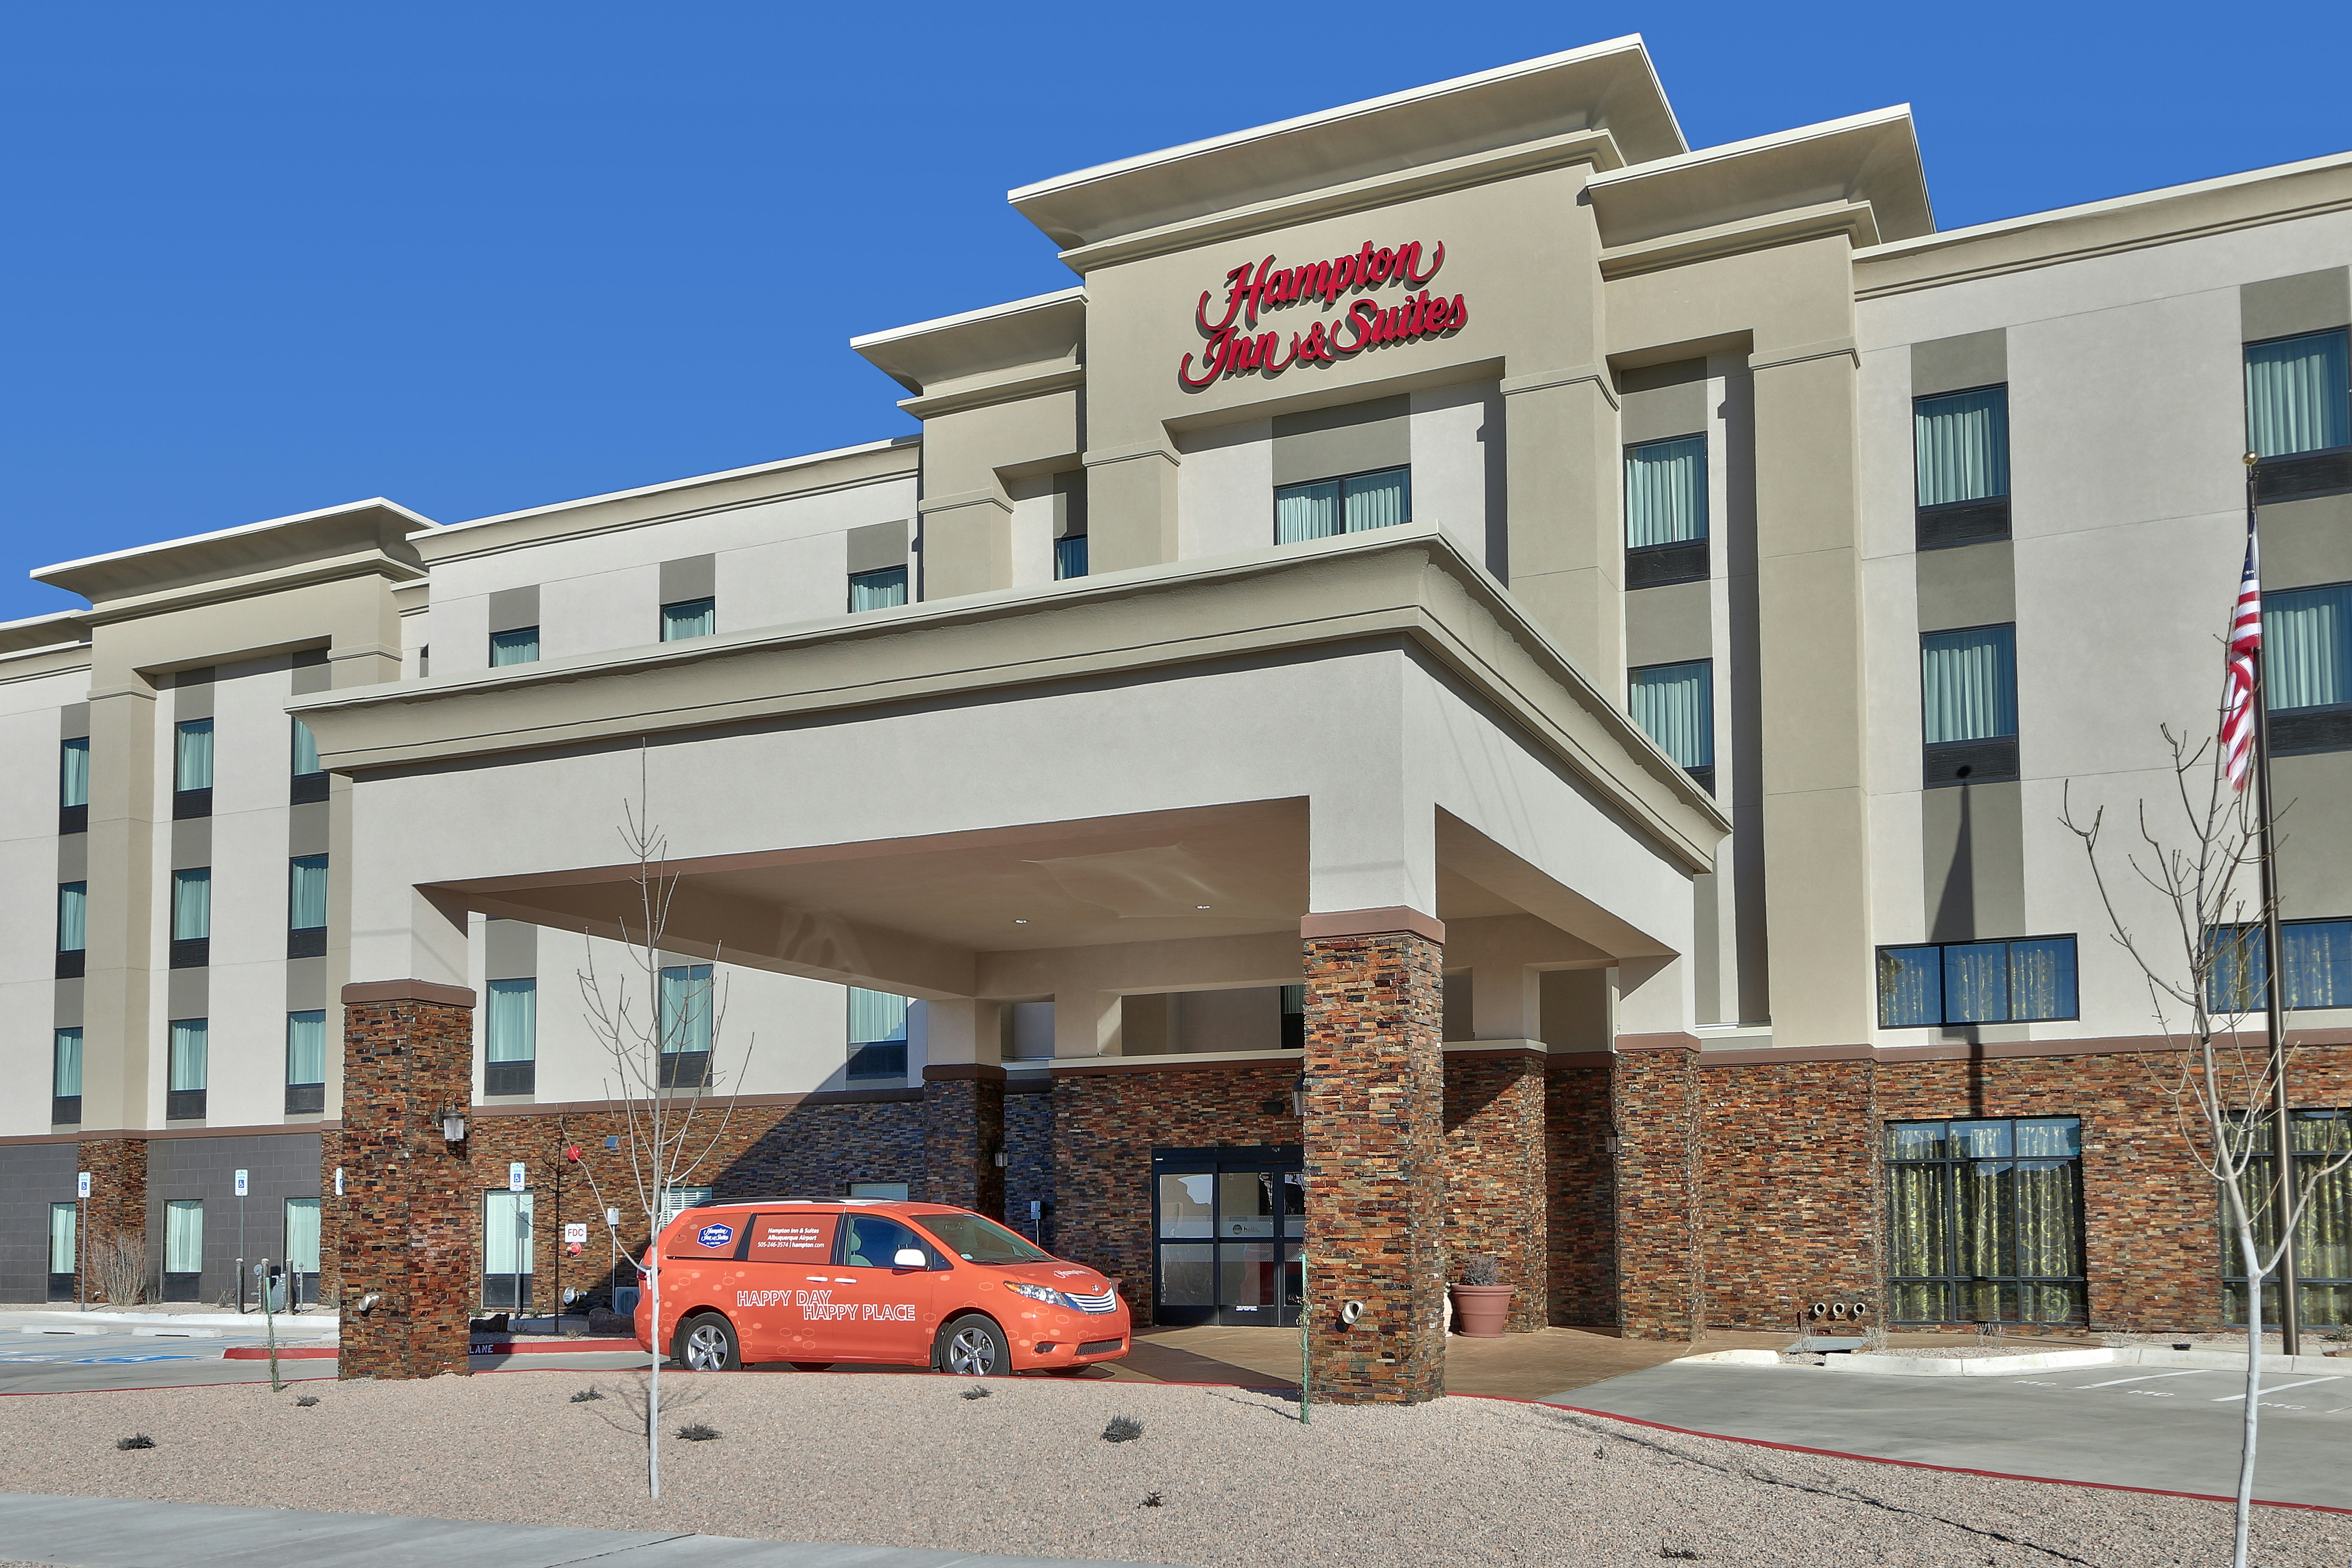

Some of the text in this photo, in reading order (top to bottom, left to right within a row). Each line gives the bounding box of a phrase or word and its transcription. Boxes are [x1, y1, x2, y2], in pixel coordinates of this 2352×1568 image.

[1198, 240, 1445, 331] Hampton
[1180, 290, 1468, 386] Inn & Suites
[737, 1290, 832, 1306] HAPPY DAY
[803, 1304, 916, 1321] HAPPY PLACE
[469, 1344, 494, 1354] LANE
